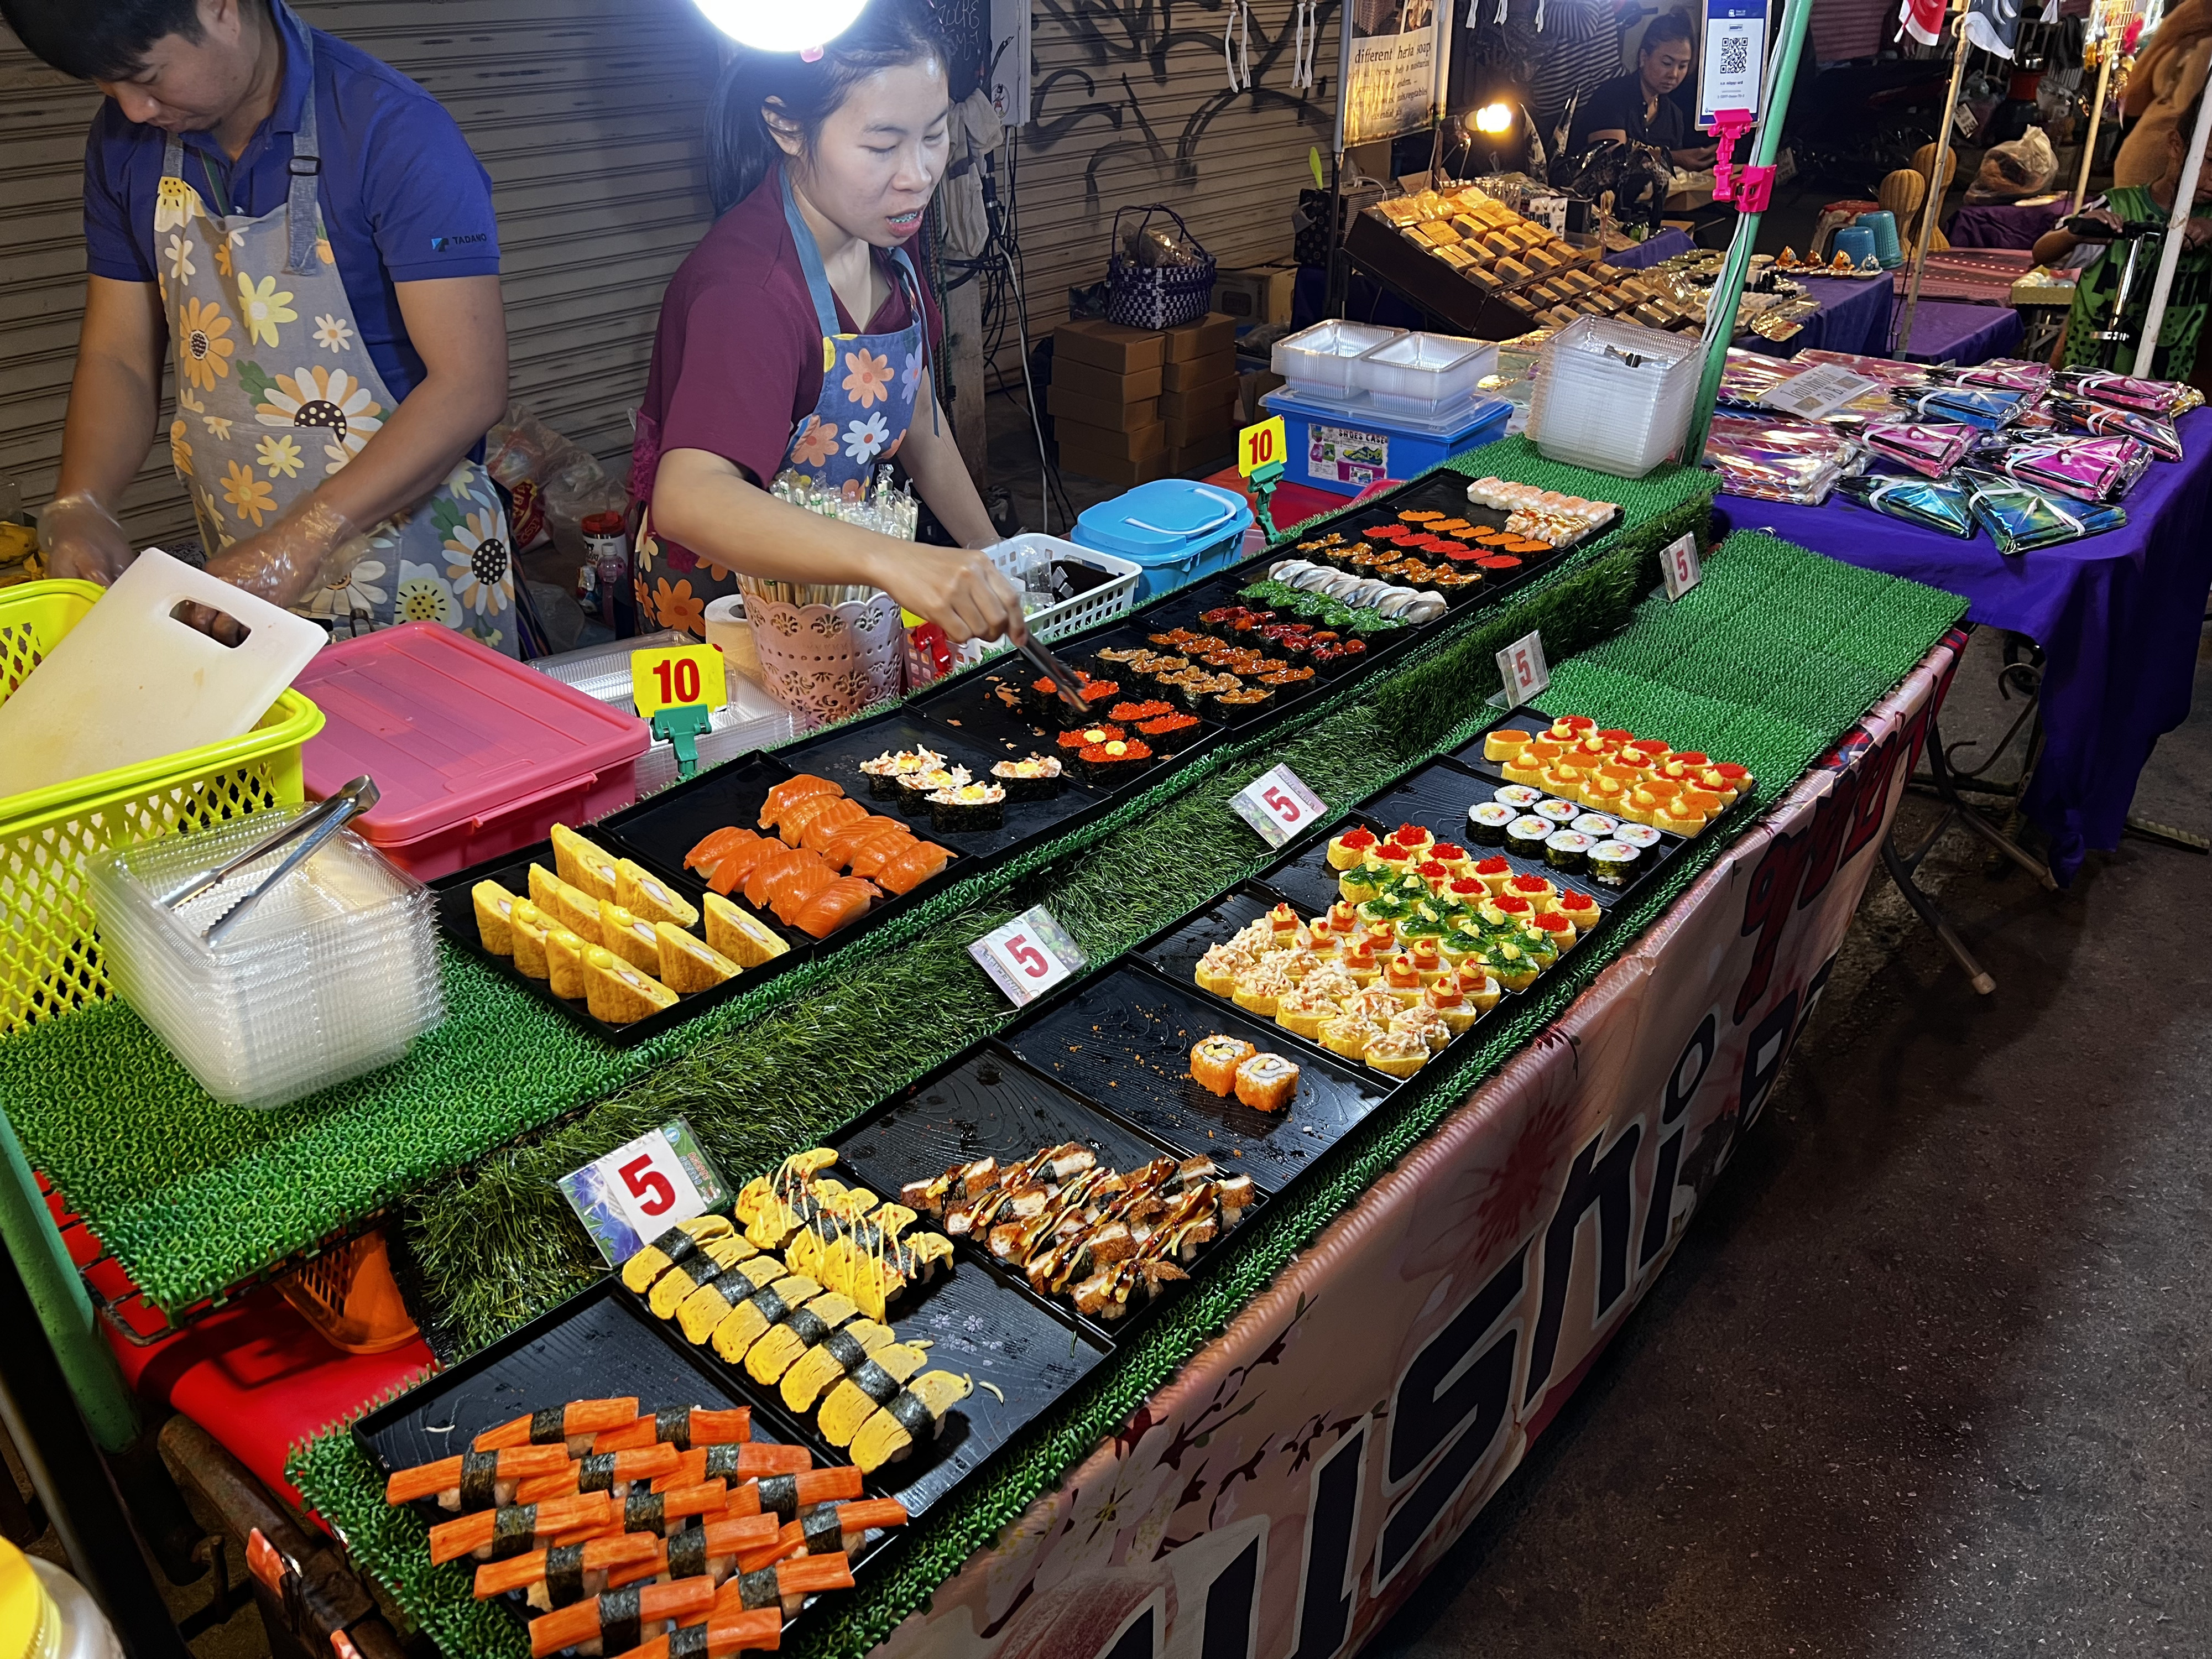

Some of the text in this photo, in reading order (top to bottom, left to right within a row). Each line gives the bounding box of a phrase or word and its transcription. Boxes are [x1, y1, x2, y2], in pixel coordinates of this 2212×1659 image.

[1355, 48, 1392, 64] different
[452, 233, 487, 246] TADANO
[1248, 429, 1272, 466] 10
[1338, 428, 1363, 440] SHOES
[1365, 432, 1385, 445] CASE
[1676, 549, 1688, 582] 5
[653, 658, 701, 704] 10
[1515, 649, 1532, 688] 5
[1261, 785, 1301, 822] 5
[1004, 933, 1049, 978] 5
[618, 1153, 676, 1216] 5
[1106, 1013, 1716, 1659] ushi
